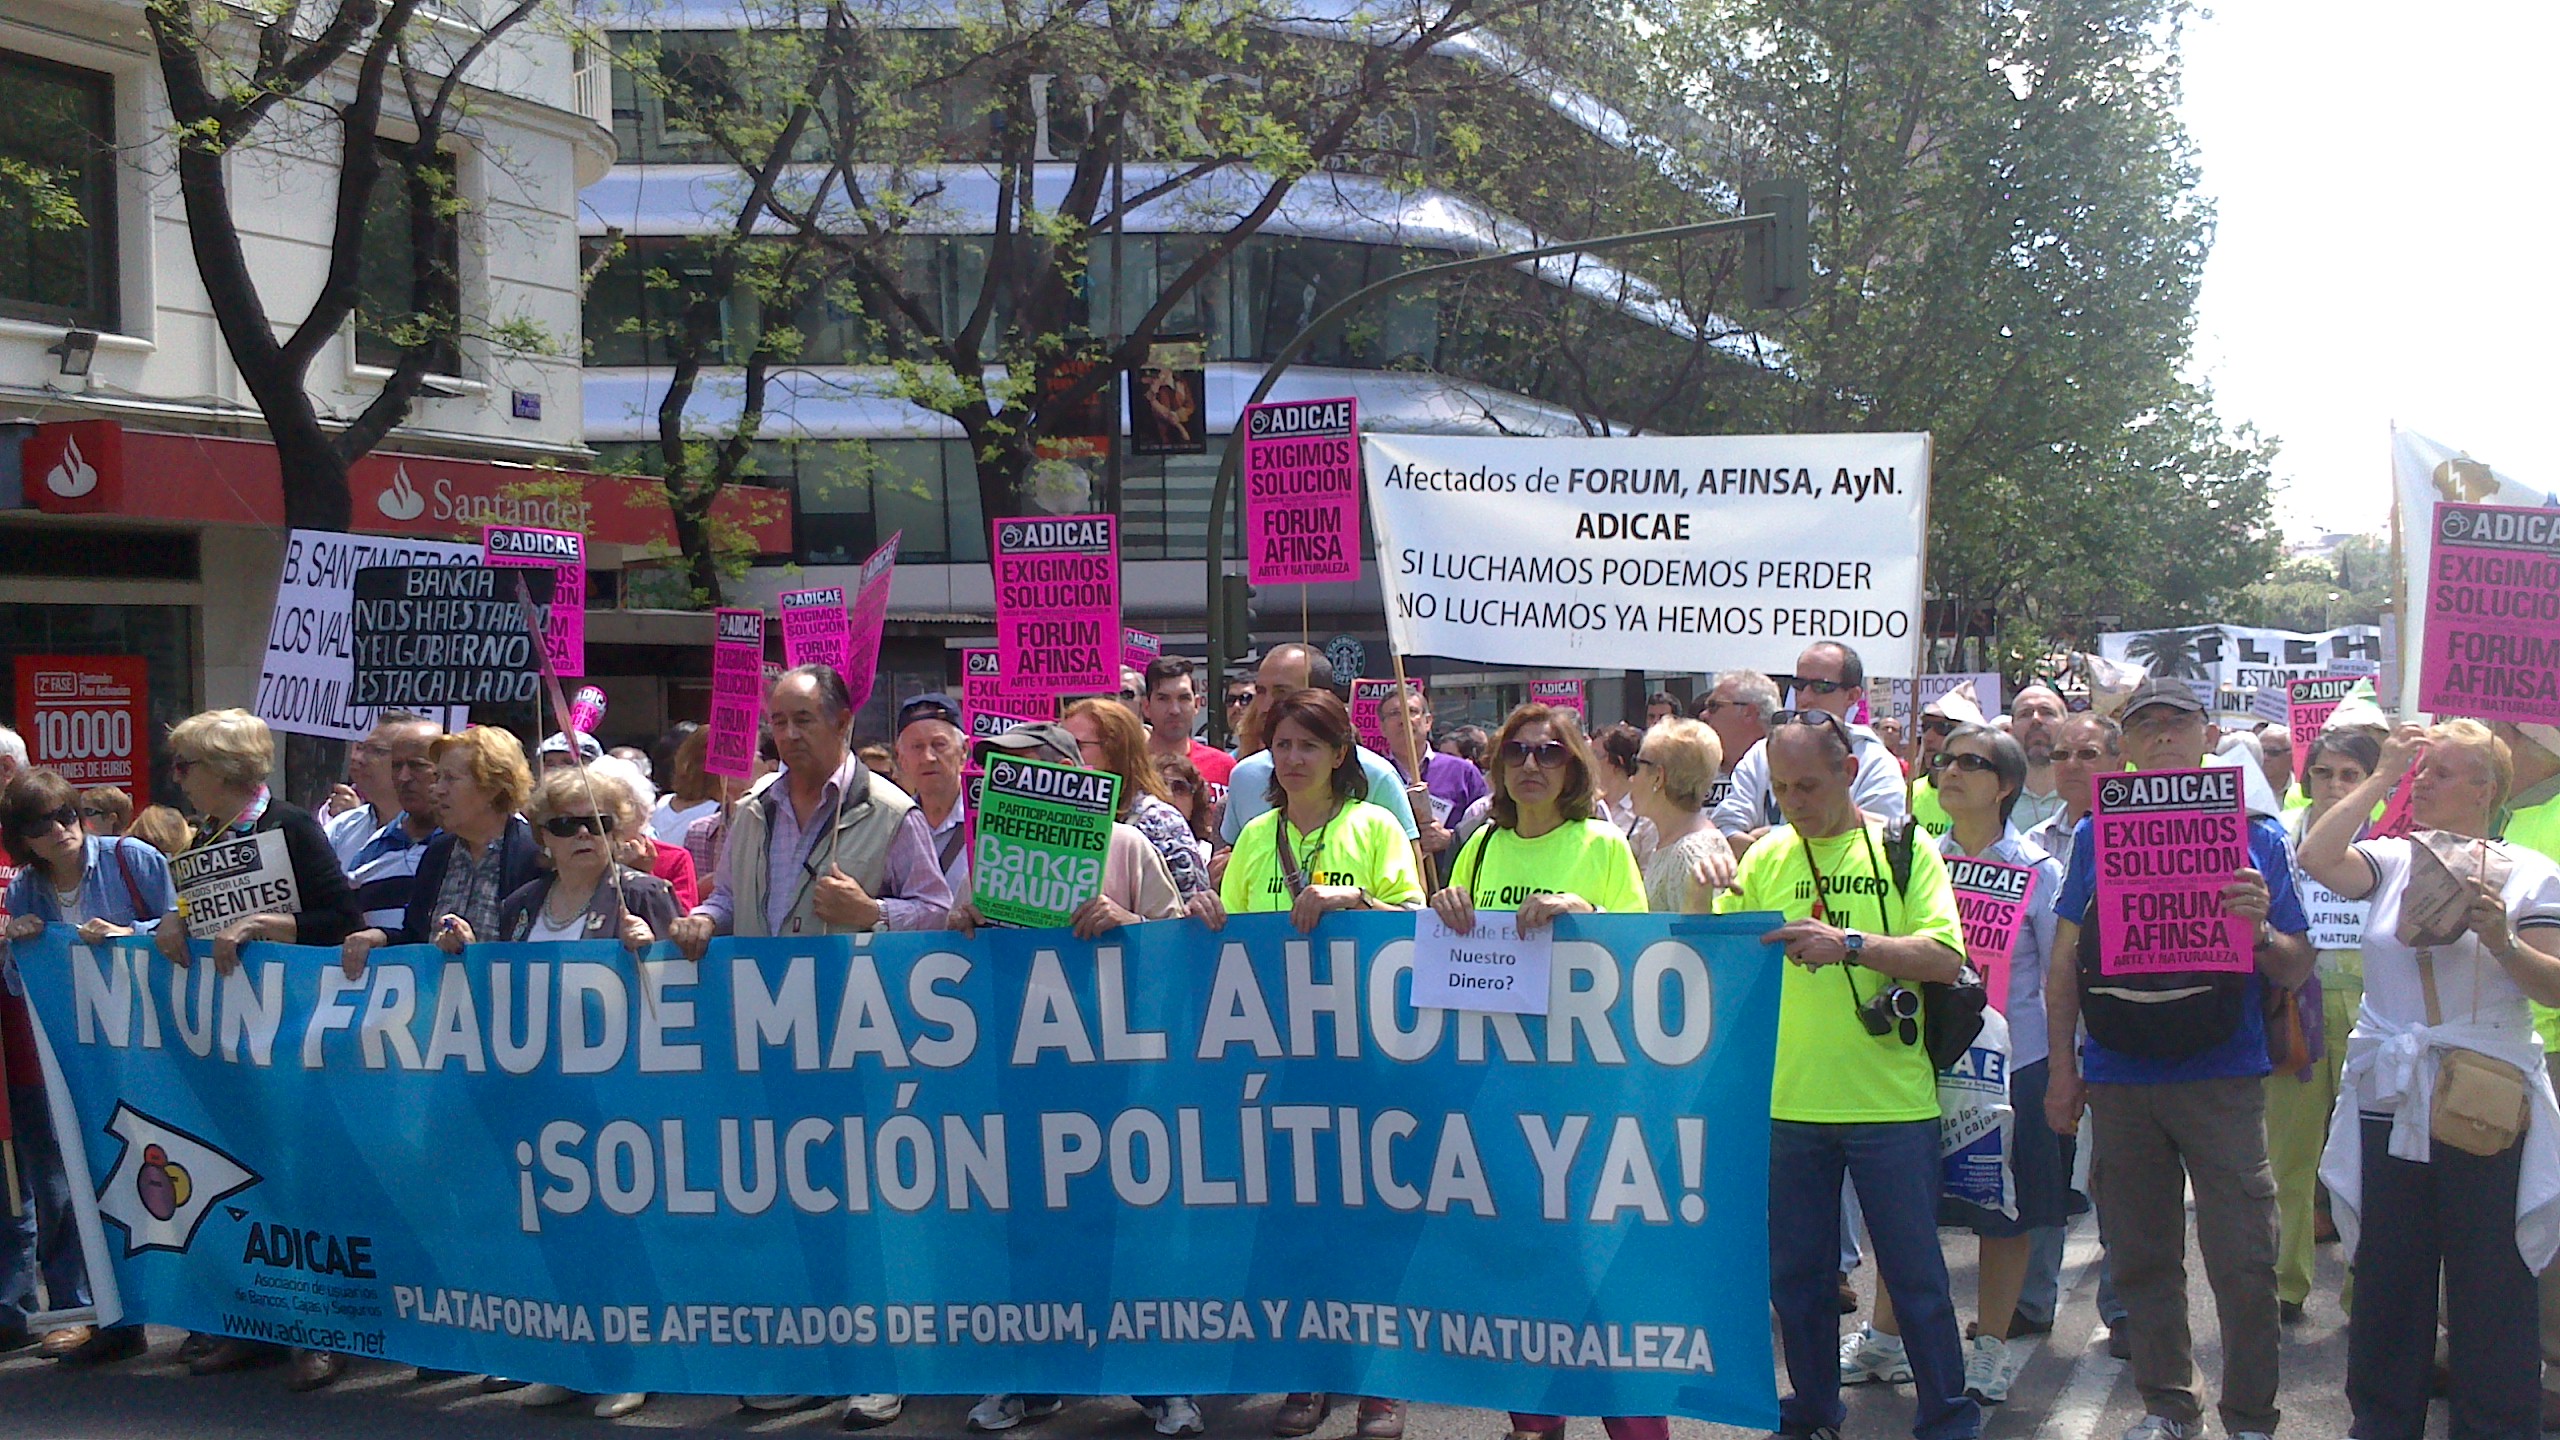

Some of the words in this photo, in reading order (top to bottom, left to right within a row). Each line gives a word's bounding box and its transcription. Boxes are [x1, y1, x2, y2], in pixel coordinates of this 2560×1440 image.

[1270, 403, 1350, 432] ADICAE
[1252, 441, 1349, 470] EXIGIMOS
[1385, 464, 1517, 493] Afectados
[1526, 465, 1559, 493] de
[1568, 468, 1689, 499] FORUM,
[1698, 468, 1821, 499] AFINSA,
[1832, 467, 1903, 502] AyN.
[433, 479, 592, 528] Santander
[1024, 521, 1109, 546] ADICAE
[1264, 506, 1341, 535] FORUM
[1576, 513, 1690, 540] ADICAE
[510, 533, 578, 555] ADICAE
[1264, 534, 1343, 563] AFINSA
[406, 569, 495, 598] BANKIA
[1002, 558, 1109, 583] EXIGIMOS
[1401, 549, 1424, 576] SI
[1433, 553, 1593, 585] LUCHAMOS
[1603, 559, 1748, 588] PODEMOS
[1758, 562, 1872, 590] PERDER
[2438, 554, 2560, 589] EXIGIMO
[796, 589, 841, 605] ADICAE
[728, 615, 760, 638] ADICAE
[785, 608, 843, 624] EXIGIMOS
[1399, 592, 1436, 621] NO
[1445, 599, 1606, 630] LUCHAMOS
[1616, 605, 1648, 632] YA
[1658, 606, 1763, 636] HEMOS
[1773, 610, 1908, 638] PERDIDO
[270, 607, 314, 653] LOS
[1017, 621, 1100, 648] FORUM
[796, 639, 841, 655] FORUM
[1017, 648, 1103, 674] AFINSA
[51, 677, 73, 691] FASE
[257, 672, 308, 723] 7.000
[1541, 682, 1578, 694] ADICAE
[34, 710, 131, 760] 10.000
[87, 762, 100, 777] DE
[101, 761, 132, 777] EUROS
[1016, 766, 1113, 803] ADICAE
[2130, 773, 2235, 805] ADICAE
[998, 802, 1095, 828] PARTICIPACIONES
[983, 813, 1106, 851] PREFERENTES
[2103, 817, 2237, 848] EXIGIMOS
[232, 875, 251, 888] LAS
[2122, 890, 2228, 922] FORUM
[2312, 913, 2360, 925] AFINSA
[2123, 921, 2230, 952] AFINSA
[1450, 949, 1516, 965] Nuestro
[1449, 973, 1514, 990] Dinero?
[72, 944, 162, 1050] NI
[170, 957, 285, 1068] UN
[302, 959, 703, 1073] FRAUDE
[733, 932, 978, 1072] MÁS
[1011, 942, 1168, 1068] AL
[1960, 1105, 1978, 1122] los
[517, 1083, 1011, 1232] ¡SOLUCIÓN
[1040, 1074, 1496, 1217] POLÍTICA
[1516, 1115, 1706, 1225] YA!
[243, 1221, 377, 1279] ADICAE
[222, 1313, 387, 1354] www.adicae.net
[394, 1285, 595, 1343] PLATAFORMA
[603, 1306, 650, 1343] DE
[660, 1306, 878, 1346] AFECTADOS
[887, 1306, 936, 1344] DE
[947, 1301, 1098, 1347] FORUM,
[1108, 1299, 1254, 1340] AFINSA
[1262, 1299, 1289, 1340] Y
[1299, 1300, 1399, 1346] ARTE
[1407, 1307, 1431, 1350] Y
[1442, 1310, 1716, 1374] NATURALEZA
